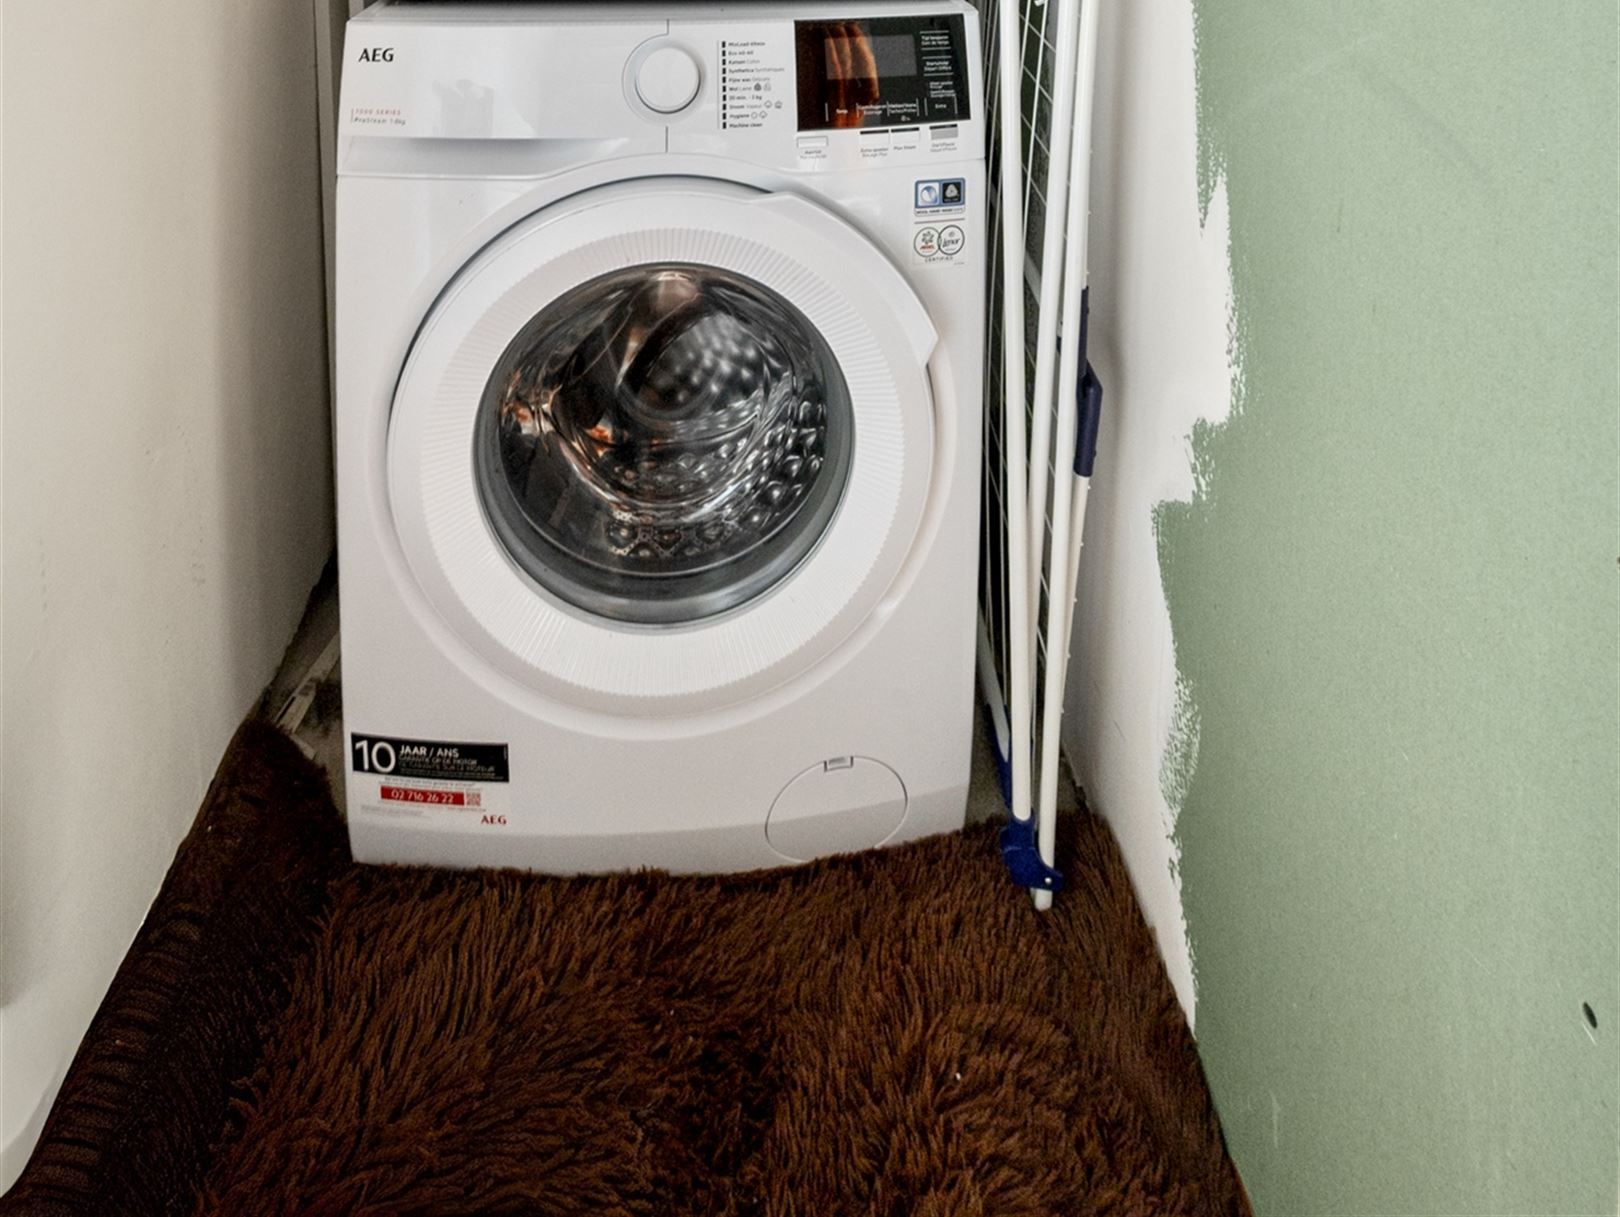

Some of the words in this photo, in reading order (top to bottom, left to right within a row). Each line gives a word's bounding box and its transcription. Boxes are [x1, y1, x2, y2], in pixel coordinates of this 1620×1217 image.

[358, 48, 394, 62] AEG
[355, 740, 396, 773] 10
[400, 745, 427, 756] JAAR
[437, 747, 459, 758] ANS
[391, 790, 404, 800] 02
[407, 791, 424, 801] 716
[426, 792, 439, 802] 26
[441, 792, 455, 803] 22
[481, 815, 507, 825] AEG
